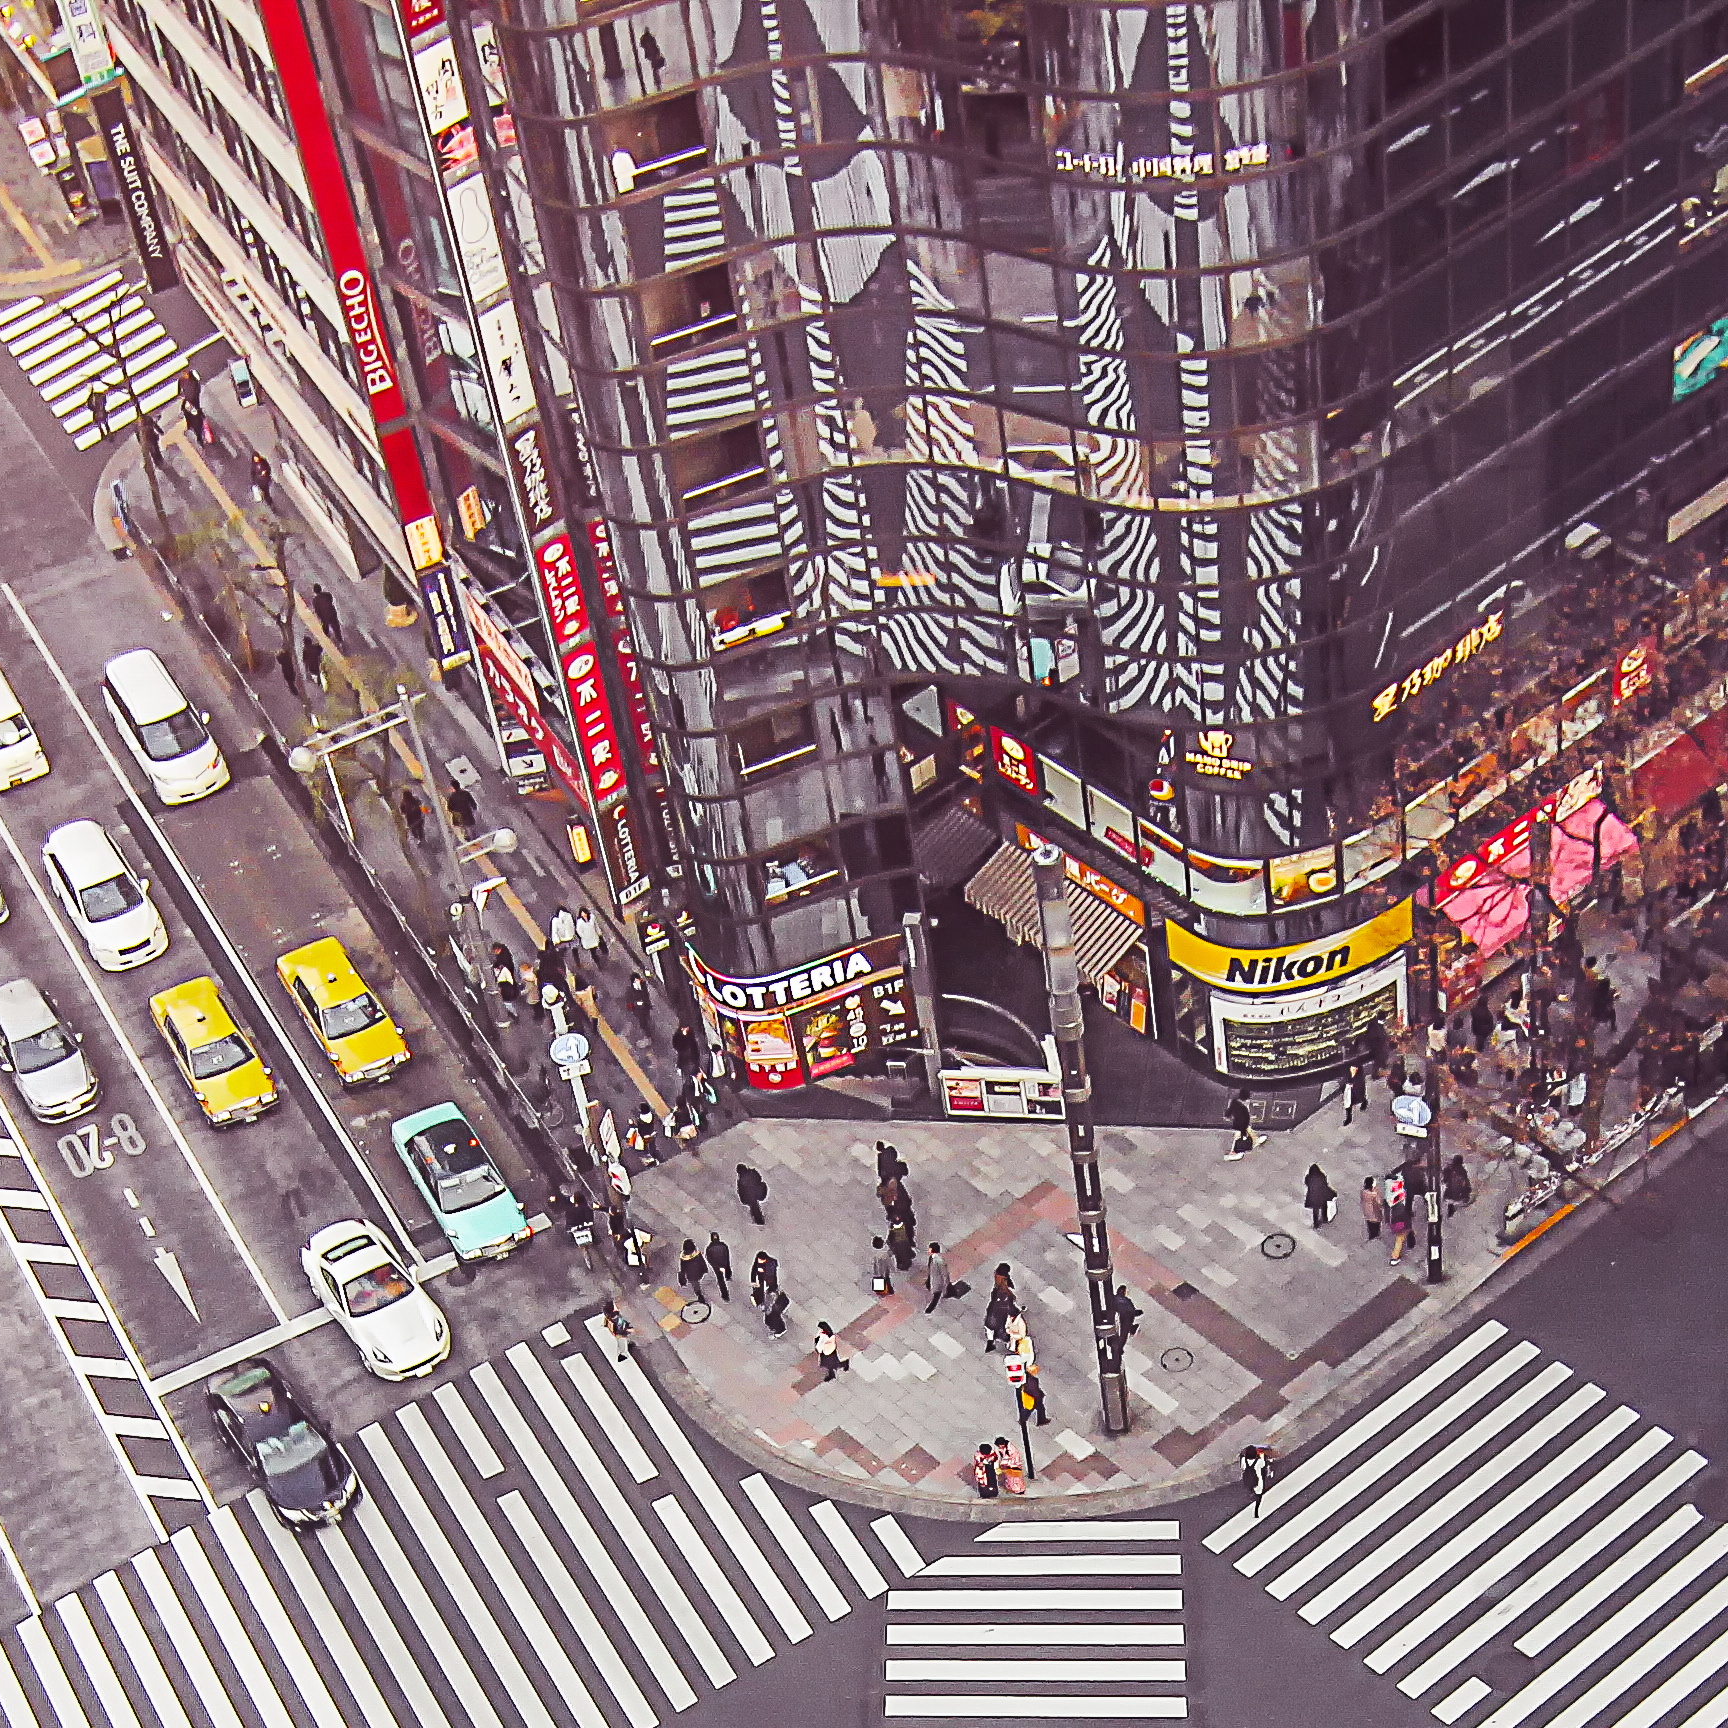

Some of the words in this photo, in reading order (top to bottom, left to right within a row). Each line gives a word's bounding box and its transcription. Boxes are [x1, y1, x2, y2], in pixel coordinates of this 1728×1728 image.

[110, 122, 131, 156] THE
[120, 154, 141, 190] SUIT
[131, 189, 163, 258] COMPANY
[616, 818, 640, 885] LOTTERIA
[706, 951, 873, 1009] LOTTERIA
[872, 978, 904, 999] B1F
[1225, 945, 1351, 985] Nikon
[56, 1112, 148, 1180] 8-20
